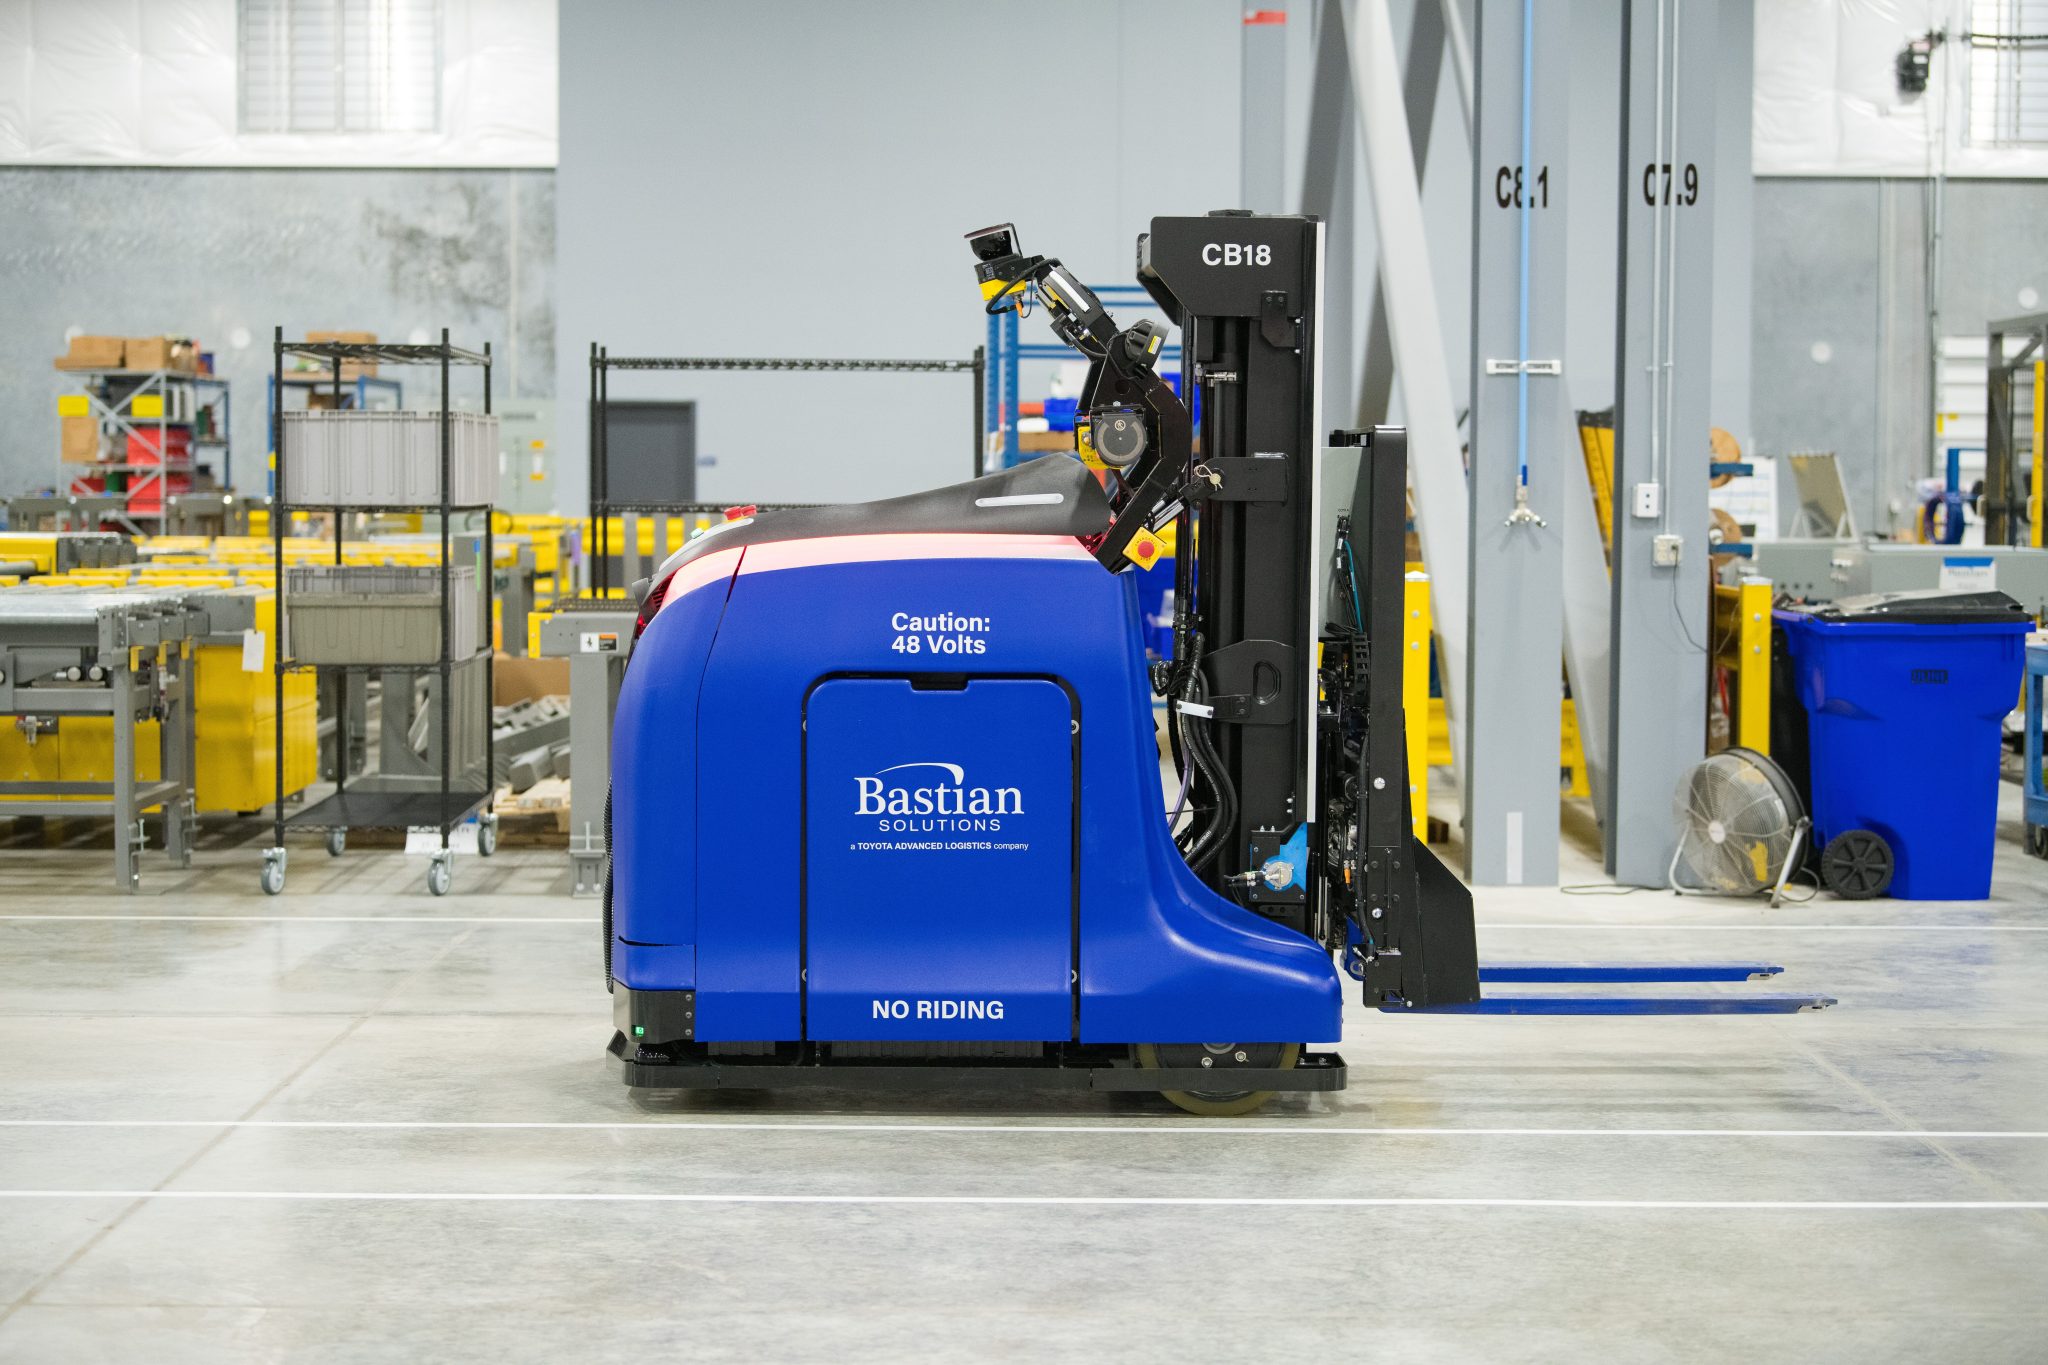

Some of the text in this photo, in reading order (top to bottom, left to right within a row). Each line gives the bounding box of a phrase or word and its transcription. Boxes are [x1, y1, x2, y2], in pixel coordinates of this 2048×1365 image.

[1643, 163, 1699, 207] C7.9
[1201, 243, 1272, 266] CB18
[891, 611, 991, 632] Caution:
[891, 634, 986, 655] 48 Volts
[853, 770, 1025, 815] Bastian
[878, 819, 1001, 832] SOLUTIONS
[857, 842, 893, 850] TOYOTA
[894, 842, 943, 850] ADVANCED
[945, 841, 992, 850] LOGISTICS
[993, 843, 1029, 852] company
[872, 1000, 1004, 1020] NO RIDING
